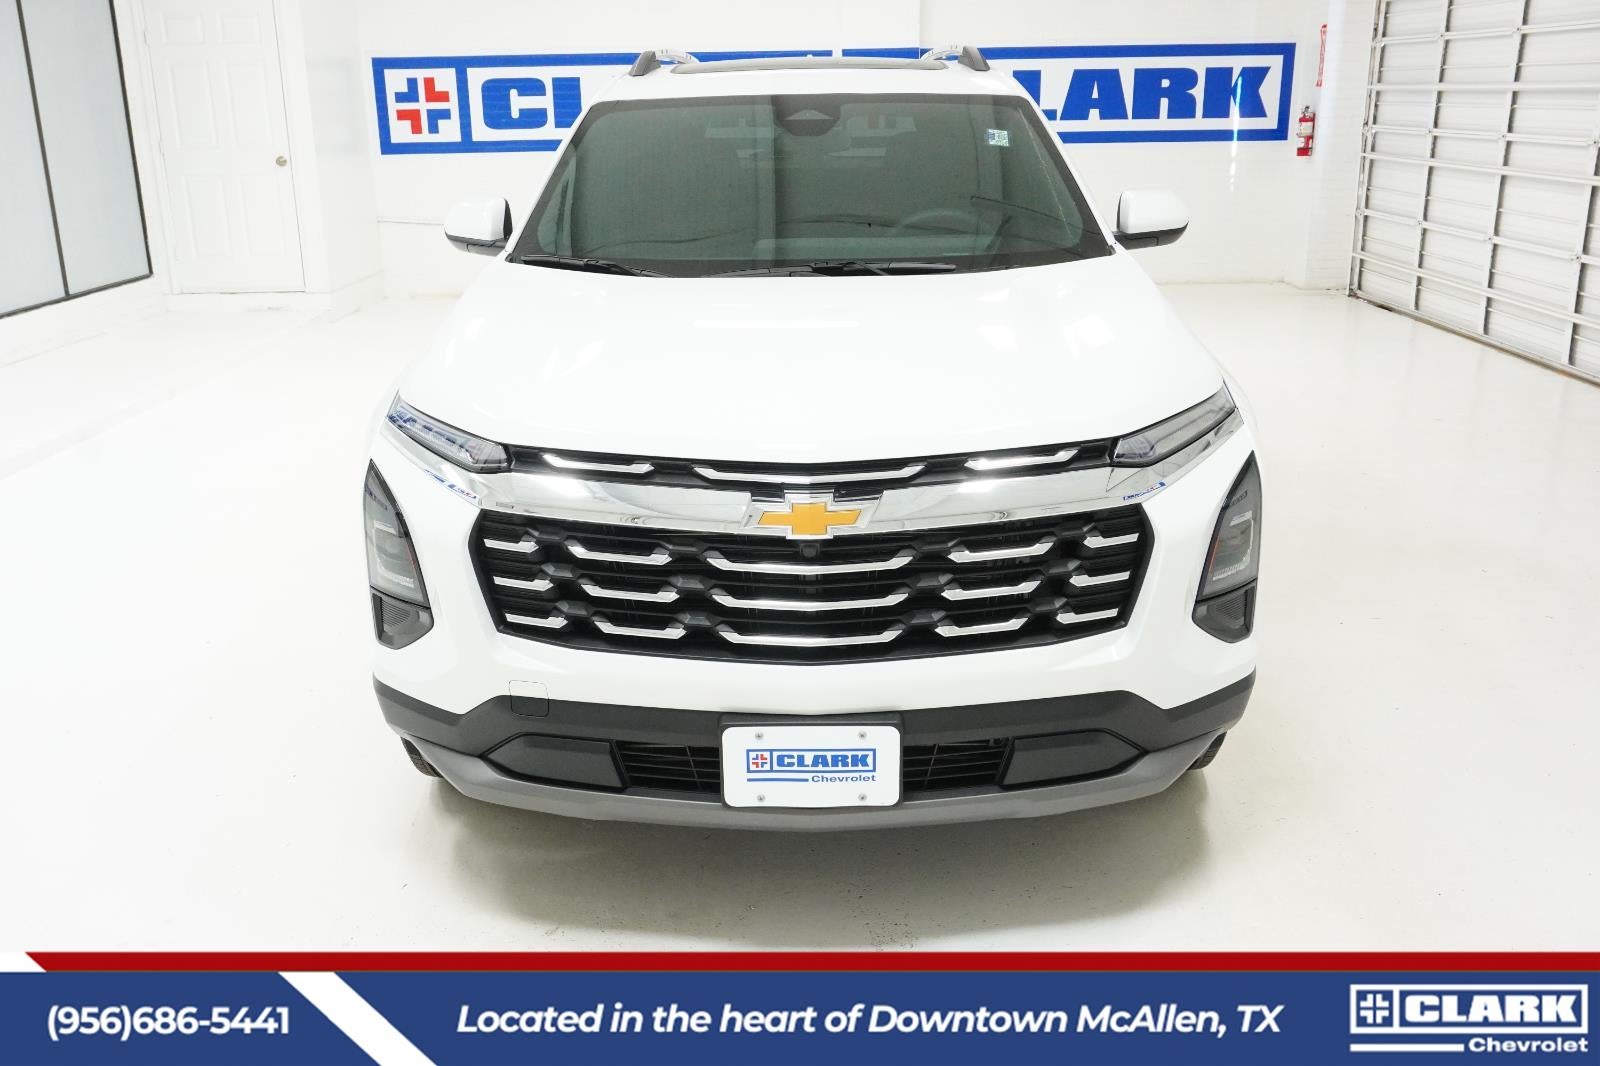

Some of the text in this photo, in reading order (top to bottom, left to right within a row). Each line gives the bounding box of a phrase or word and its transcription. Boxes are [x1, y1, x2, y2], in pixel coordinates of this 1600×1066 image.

[1012, 66, 1271, 121] LARK
[776, 753, 870, 768] CLARK
[811, 774, 876, 783] Chevrolet
